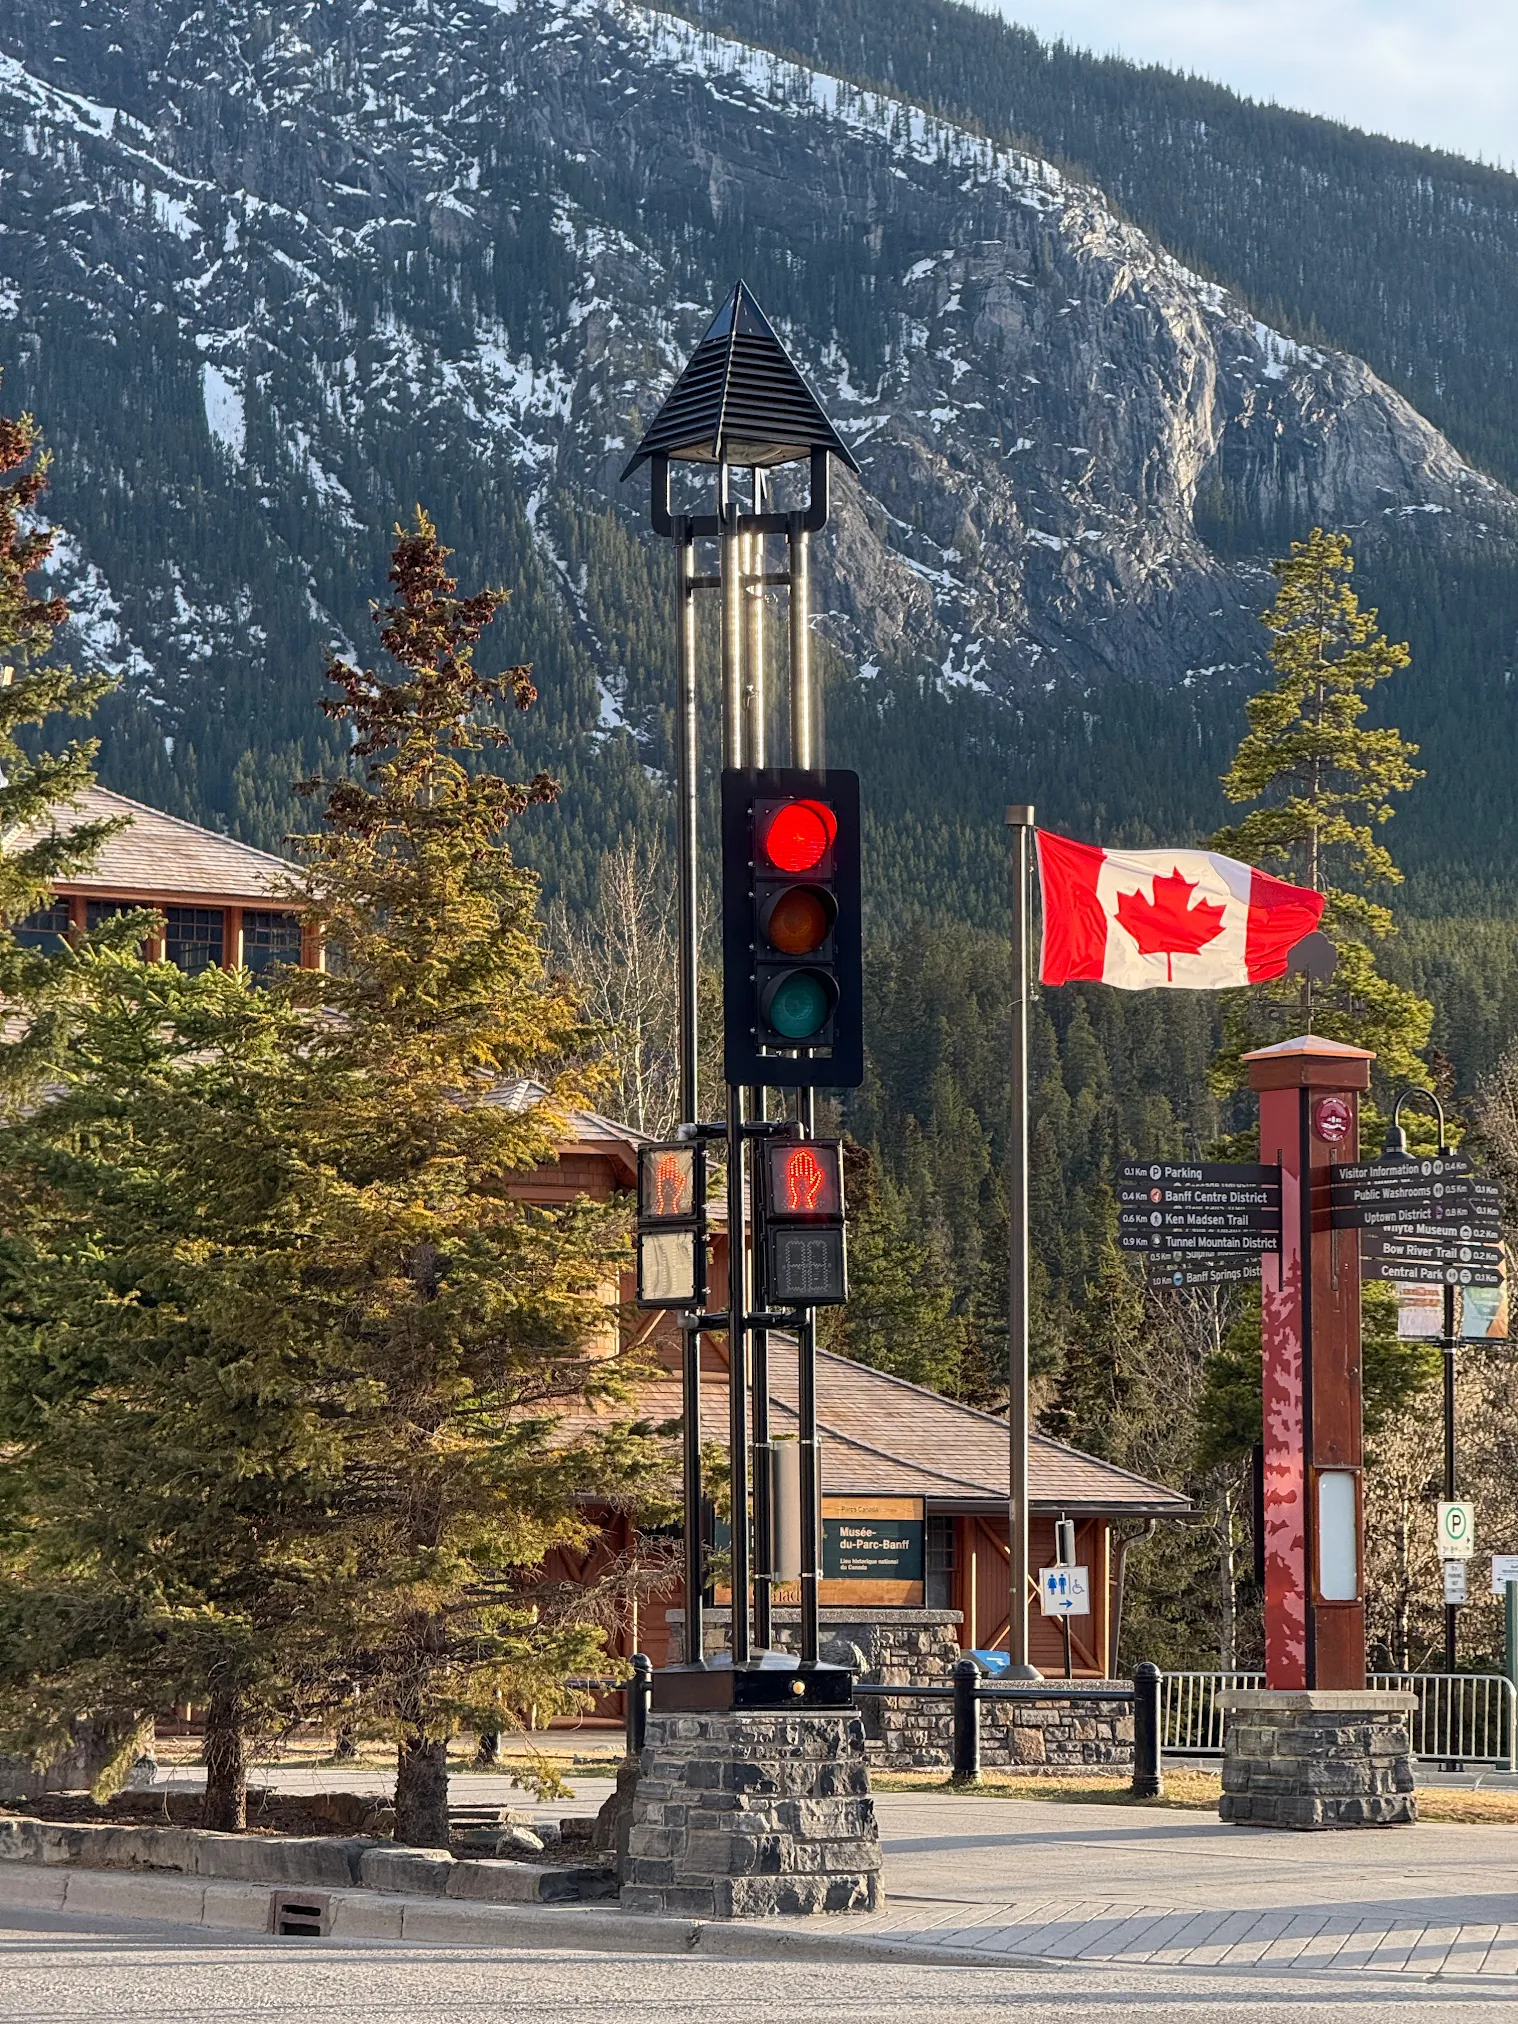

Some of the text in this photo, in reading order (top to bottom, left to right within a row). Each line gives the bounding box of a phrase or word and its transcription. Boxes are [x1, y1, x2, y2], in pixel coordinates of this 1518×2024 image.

[1124, 1168, 1135, 1176] 0.1
[1135, 1168, 1147, 1177] Km
[1164, 1167, 1202, 1180] Parking
[1340, 1168, 1367, 1180] Visitor
[1370, 1164, 1419, 1177] Information
[1456, 1162, 1467, 1170] Km
[1354, 1185, 1467, 1200] Public Washrooms 0.5 Km
[1486, 1186, 1498, 1194] Km
[1122, 1191, 1267, 1203] 0.4 Km Banff Centre District
[1364, 1211, 1396, 1225] Uptown
[1398, 1208, 1431, 1221] District
[1457, 1208, 1468, 1216] Km
[1487, 1208, 1499, 1216] Km
[1122, 1214, 1249, 1226] 0.6 Km Ken Madsen Trail
[1416, 1224, 1457, 1236] Museum
[1473, 1230, 1484, 1238] 0.2
[1486, 1231, 1498, 1239] Km
[1123, 1236, 1277, 1249] 0.9 Km Tunnel Mountain District
[1150, 1253, 1160, 1261] 0.5
[1160, 1252, 1171, 1260] Km
[1383, 1243, 1498, 1261] Bow River Trail 0.2 Km
[1162, 1276, 1172, 1284] Km
[1186, 1271, 1209, 1283] Banff
[1210, 1268, 1241, 1282] Springs
[1382, 1265, 1417, 1277] Central
[1420, 1268, 1443, 1280] Park
[1486, 1274, 1498, 1282] Km
[1452, 1515, 1461, 1533] P
[840, 1527, 876, 1536] Musée-
[840, 1539, 910, 1550] du-Parc-Banff
